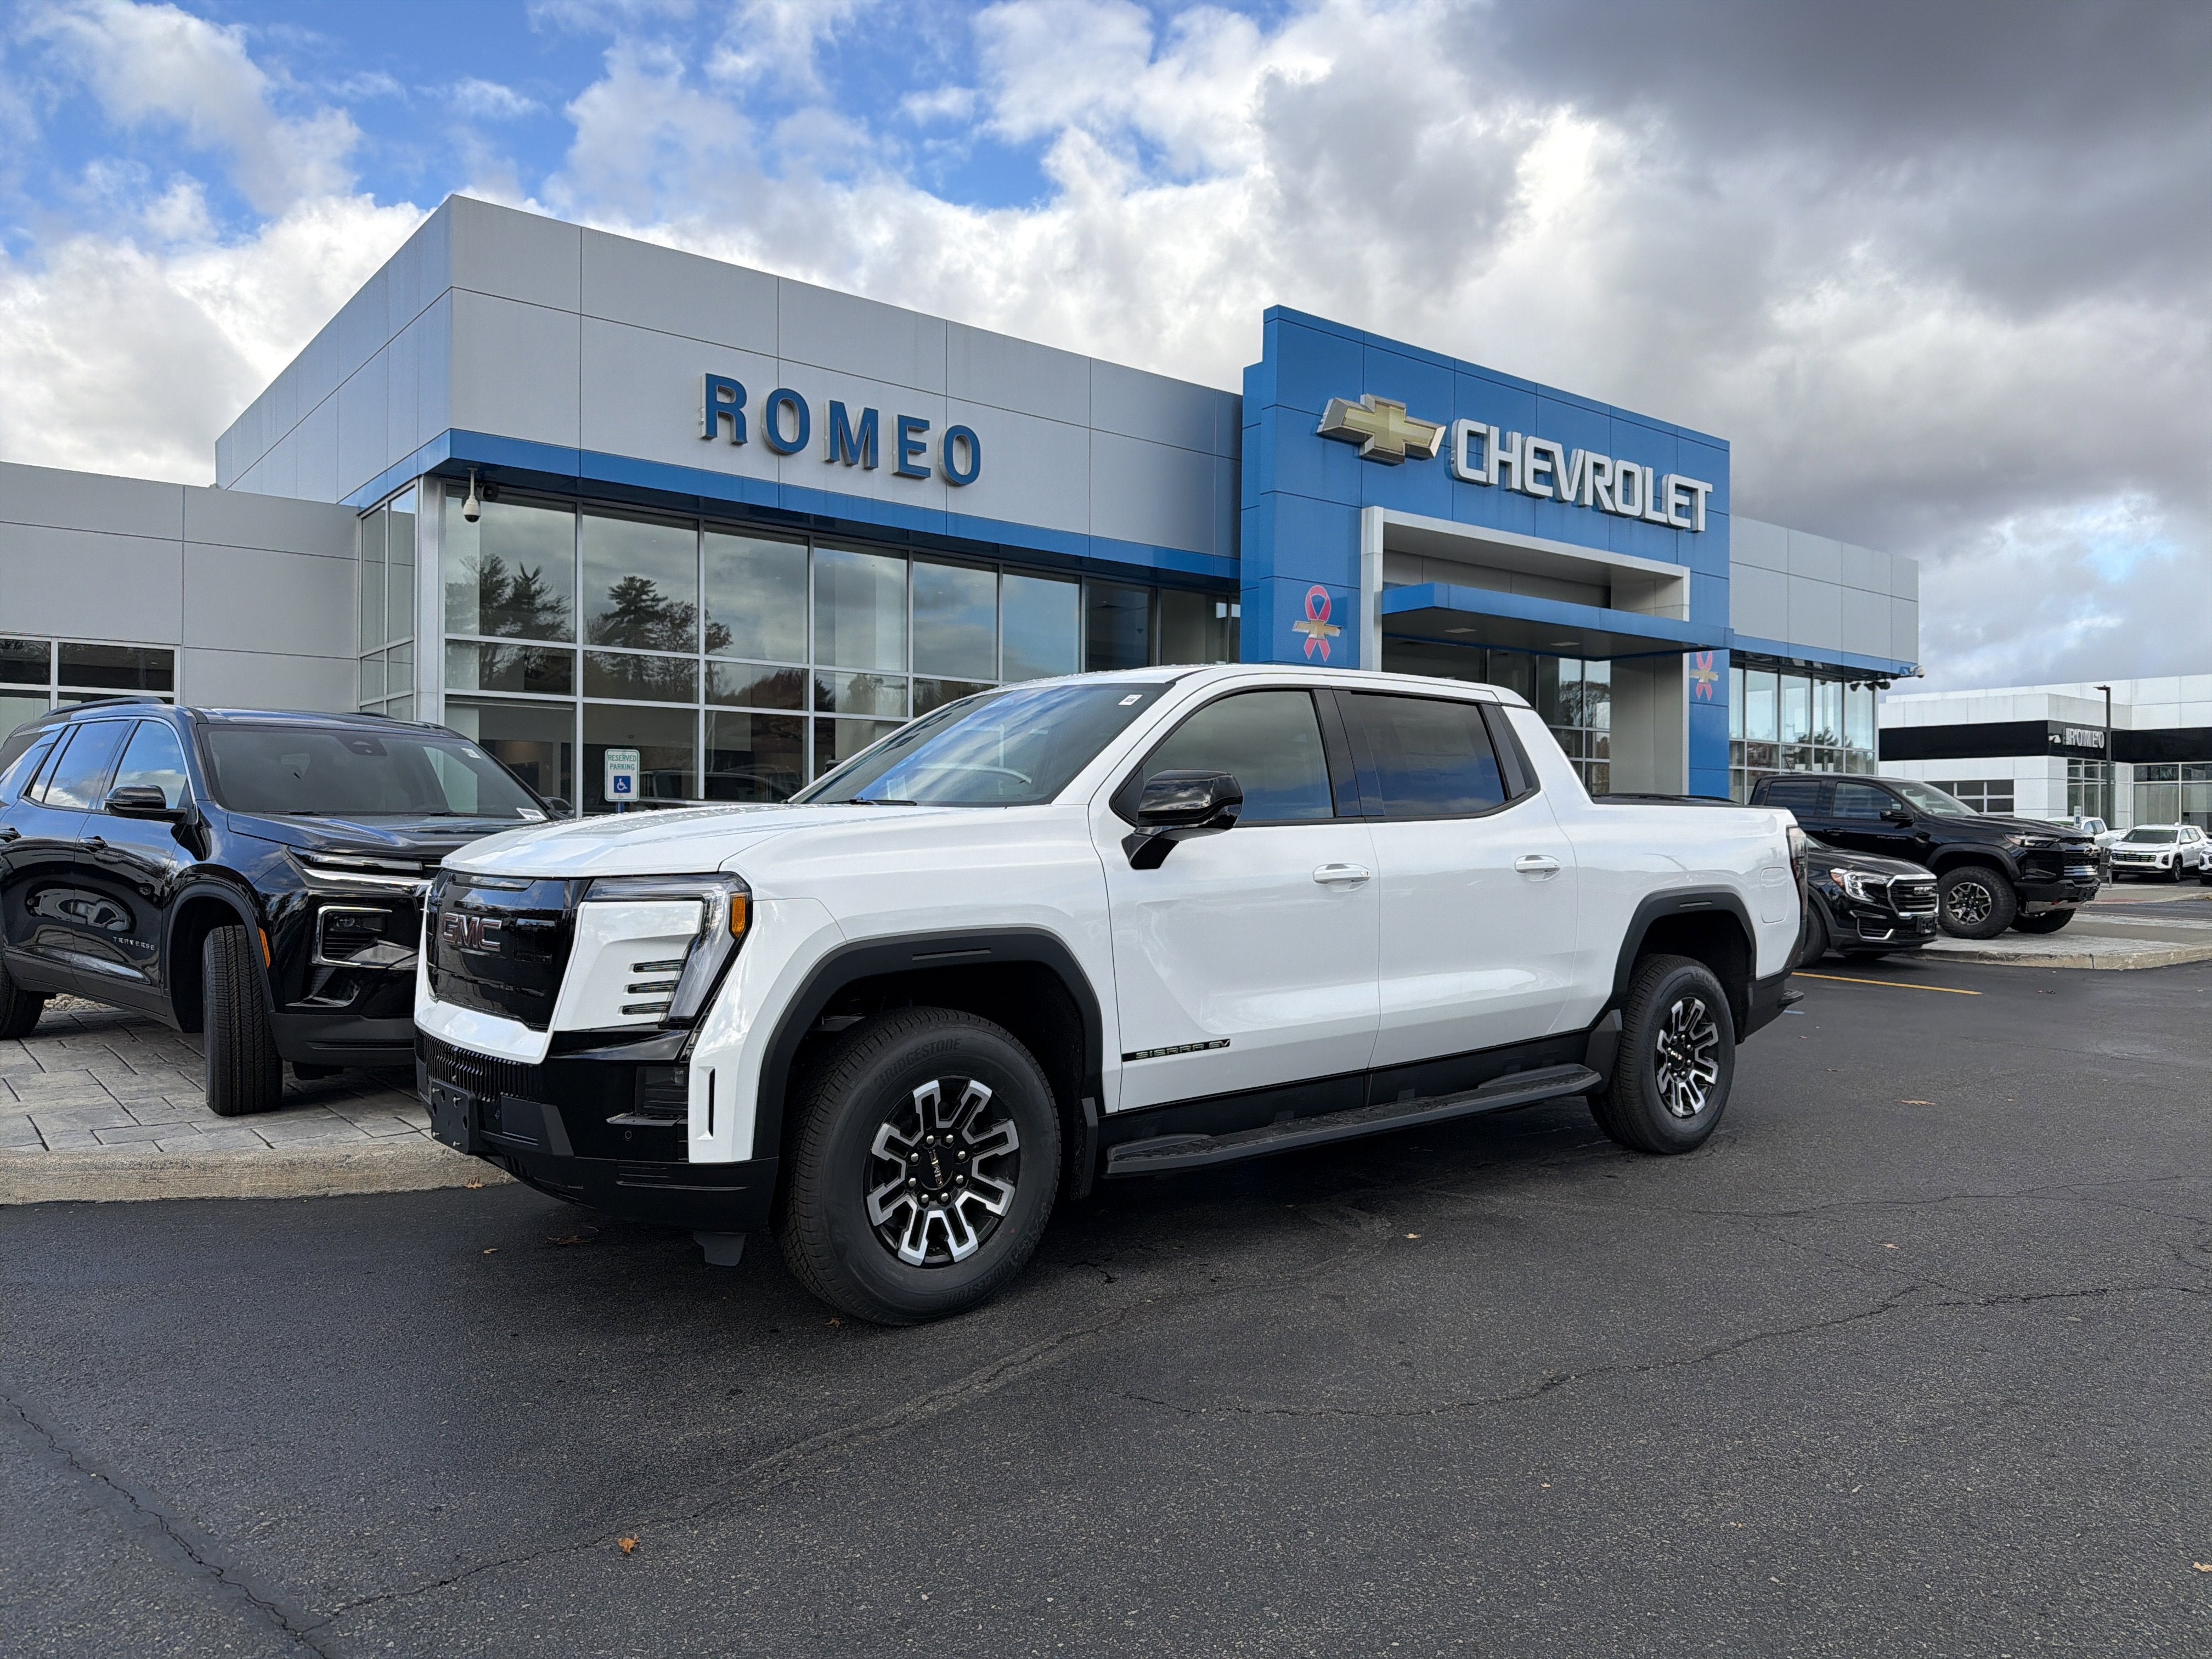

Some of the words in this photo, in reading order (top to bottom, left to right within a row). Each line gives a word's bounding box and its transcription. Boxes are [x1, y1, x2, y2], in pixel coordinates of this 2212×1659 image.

[700, 373, 981, 487] ROMEO
[1451, 418, 1713, 533] CHEVROLET
[2065, 727, 2104, 749] ROMEO
[112, 936, 155, 951] TRAVERSE
[442, 912, 503, 952] GMC
[874, 1038, 961, 1090] BRIDGESTONE
[1136, 1043, 1204, 1059] SIERRA
[1209, 1040, 1230, 1049] EV
